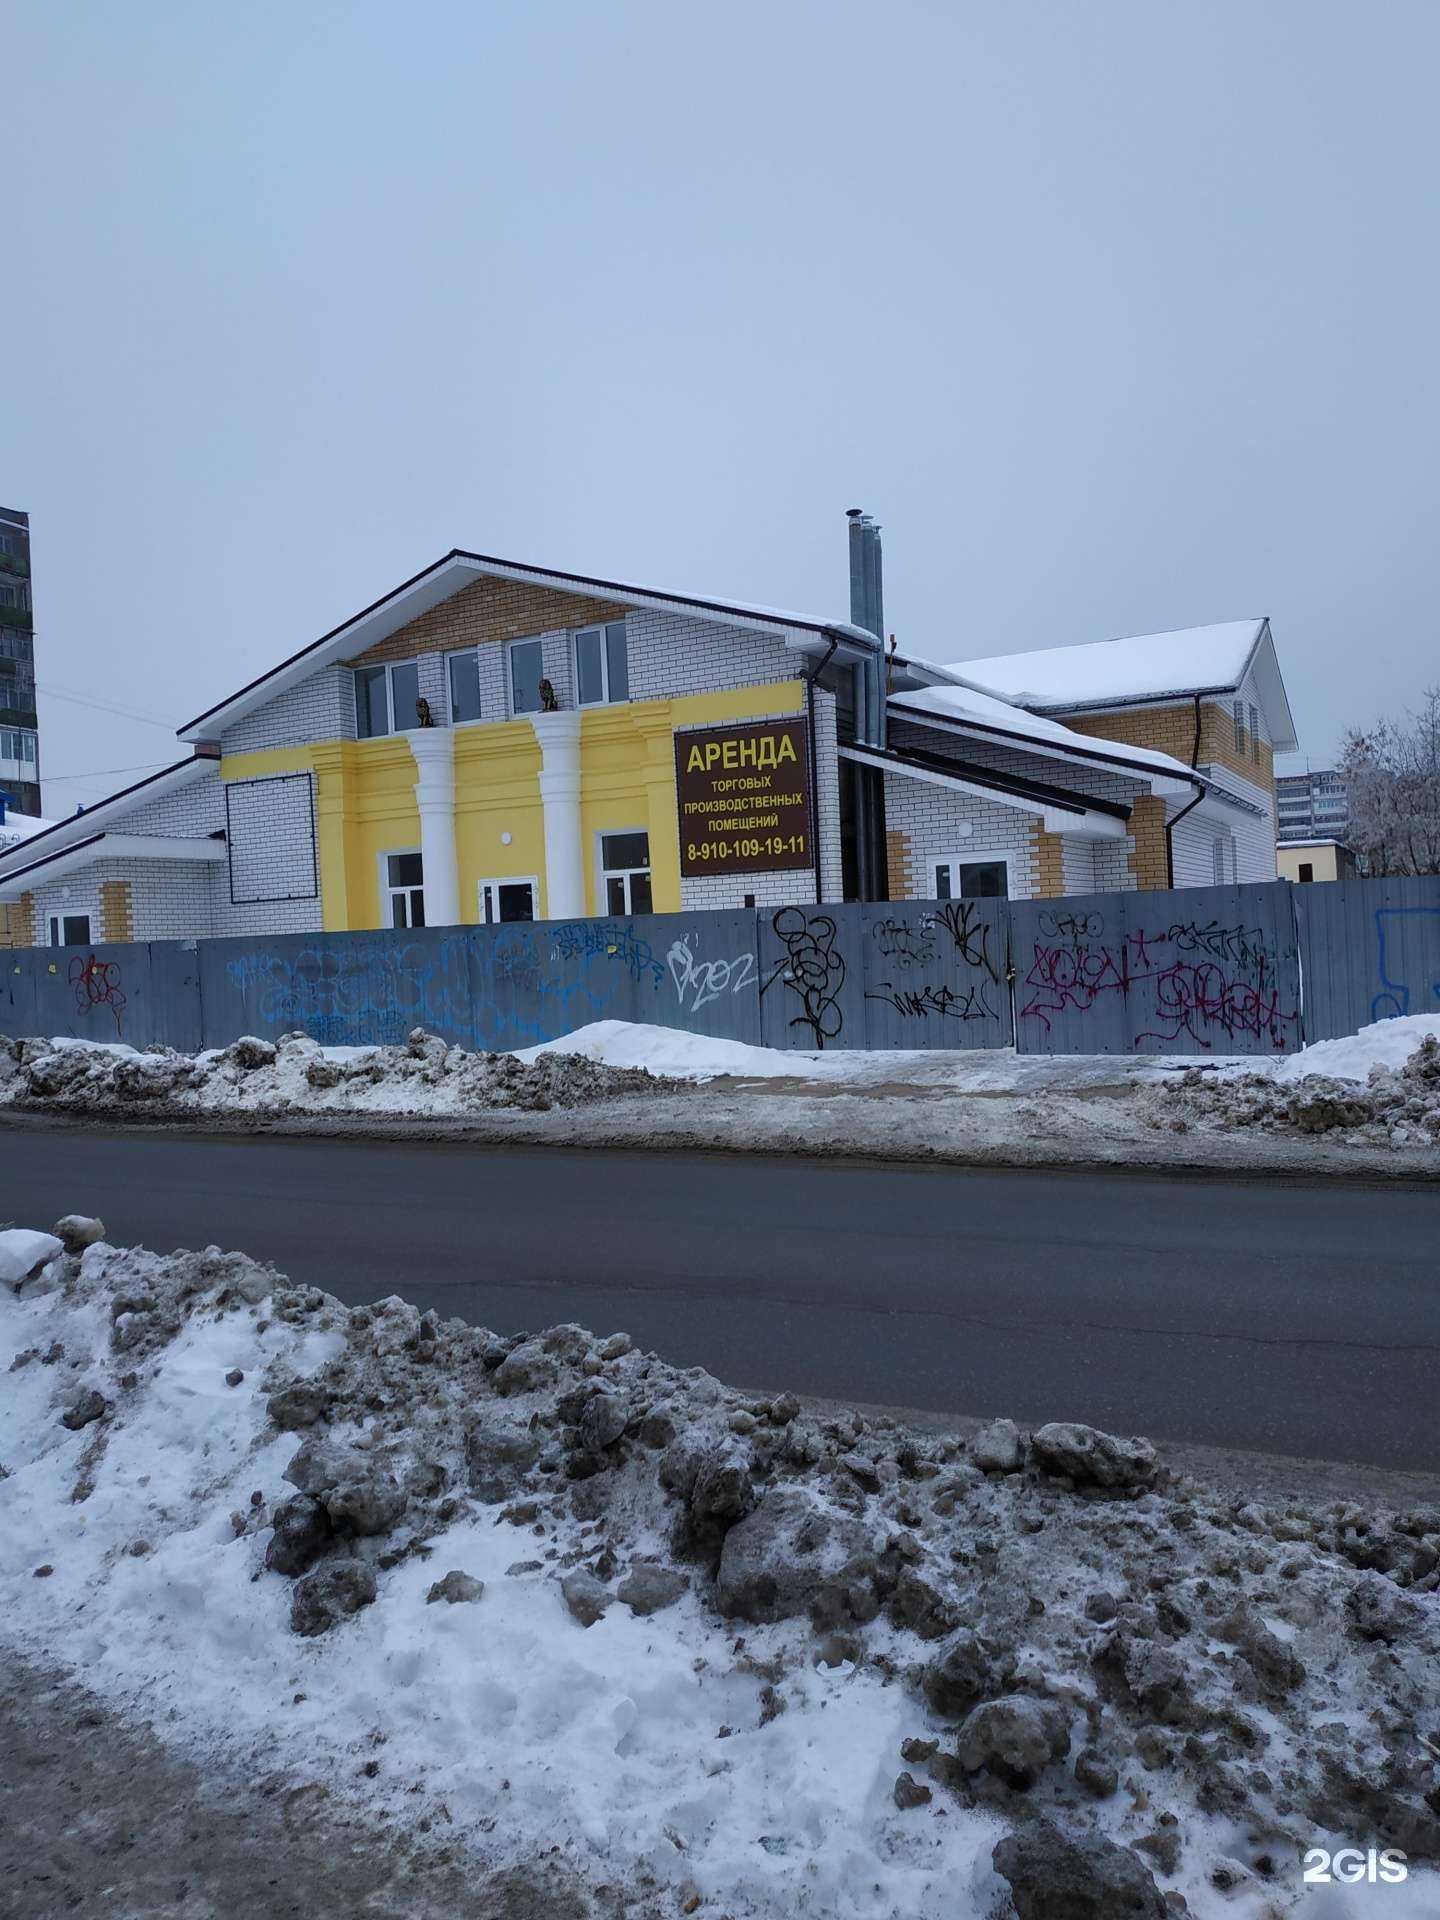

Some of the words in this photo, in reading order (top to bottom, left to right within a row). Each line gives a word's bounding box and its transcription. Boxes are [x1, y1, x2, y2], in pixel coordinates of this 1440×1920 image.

[686, 734, 797, 773] АРЕНДА
[711, 775, 772, 793] ТОРГОВЫХ
[684, 792, 804, 815] ПРОИЗВОДСТВЕННЫХ
[708, 812, 779, 832] ПОМЕЩЕНИЙ
[687, 835, 804, 861] 8-910-109-19-11
